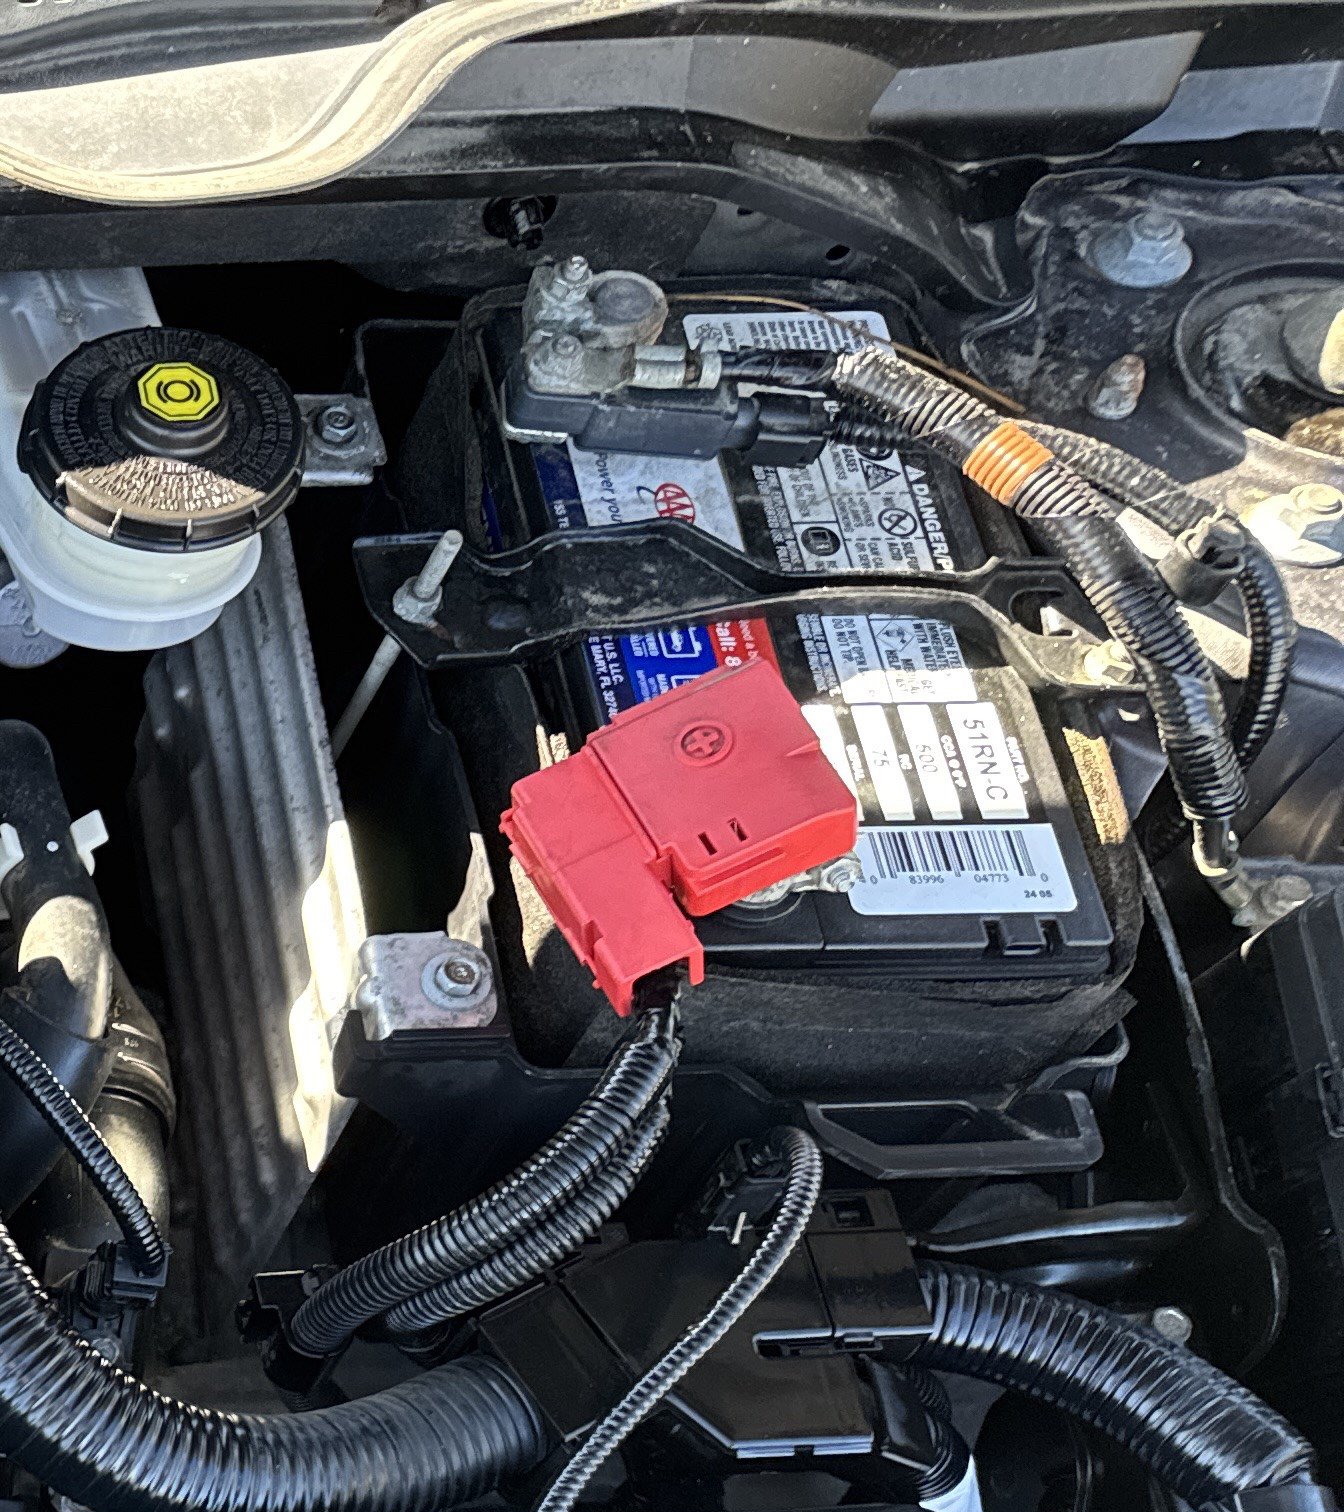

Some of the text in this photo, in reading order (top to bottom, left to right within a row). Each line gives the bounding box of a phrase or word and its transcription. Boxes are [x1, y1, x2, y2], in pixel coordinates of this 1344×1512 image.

[961, 718, 1010, 800] 51RN-C
[909, 874, 945, 885] 83996
[973, 873, 1010, 884] 04773
